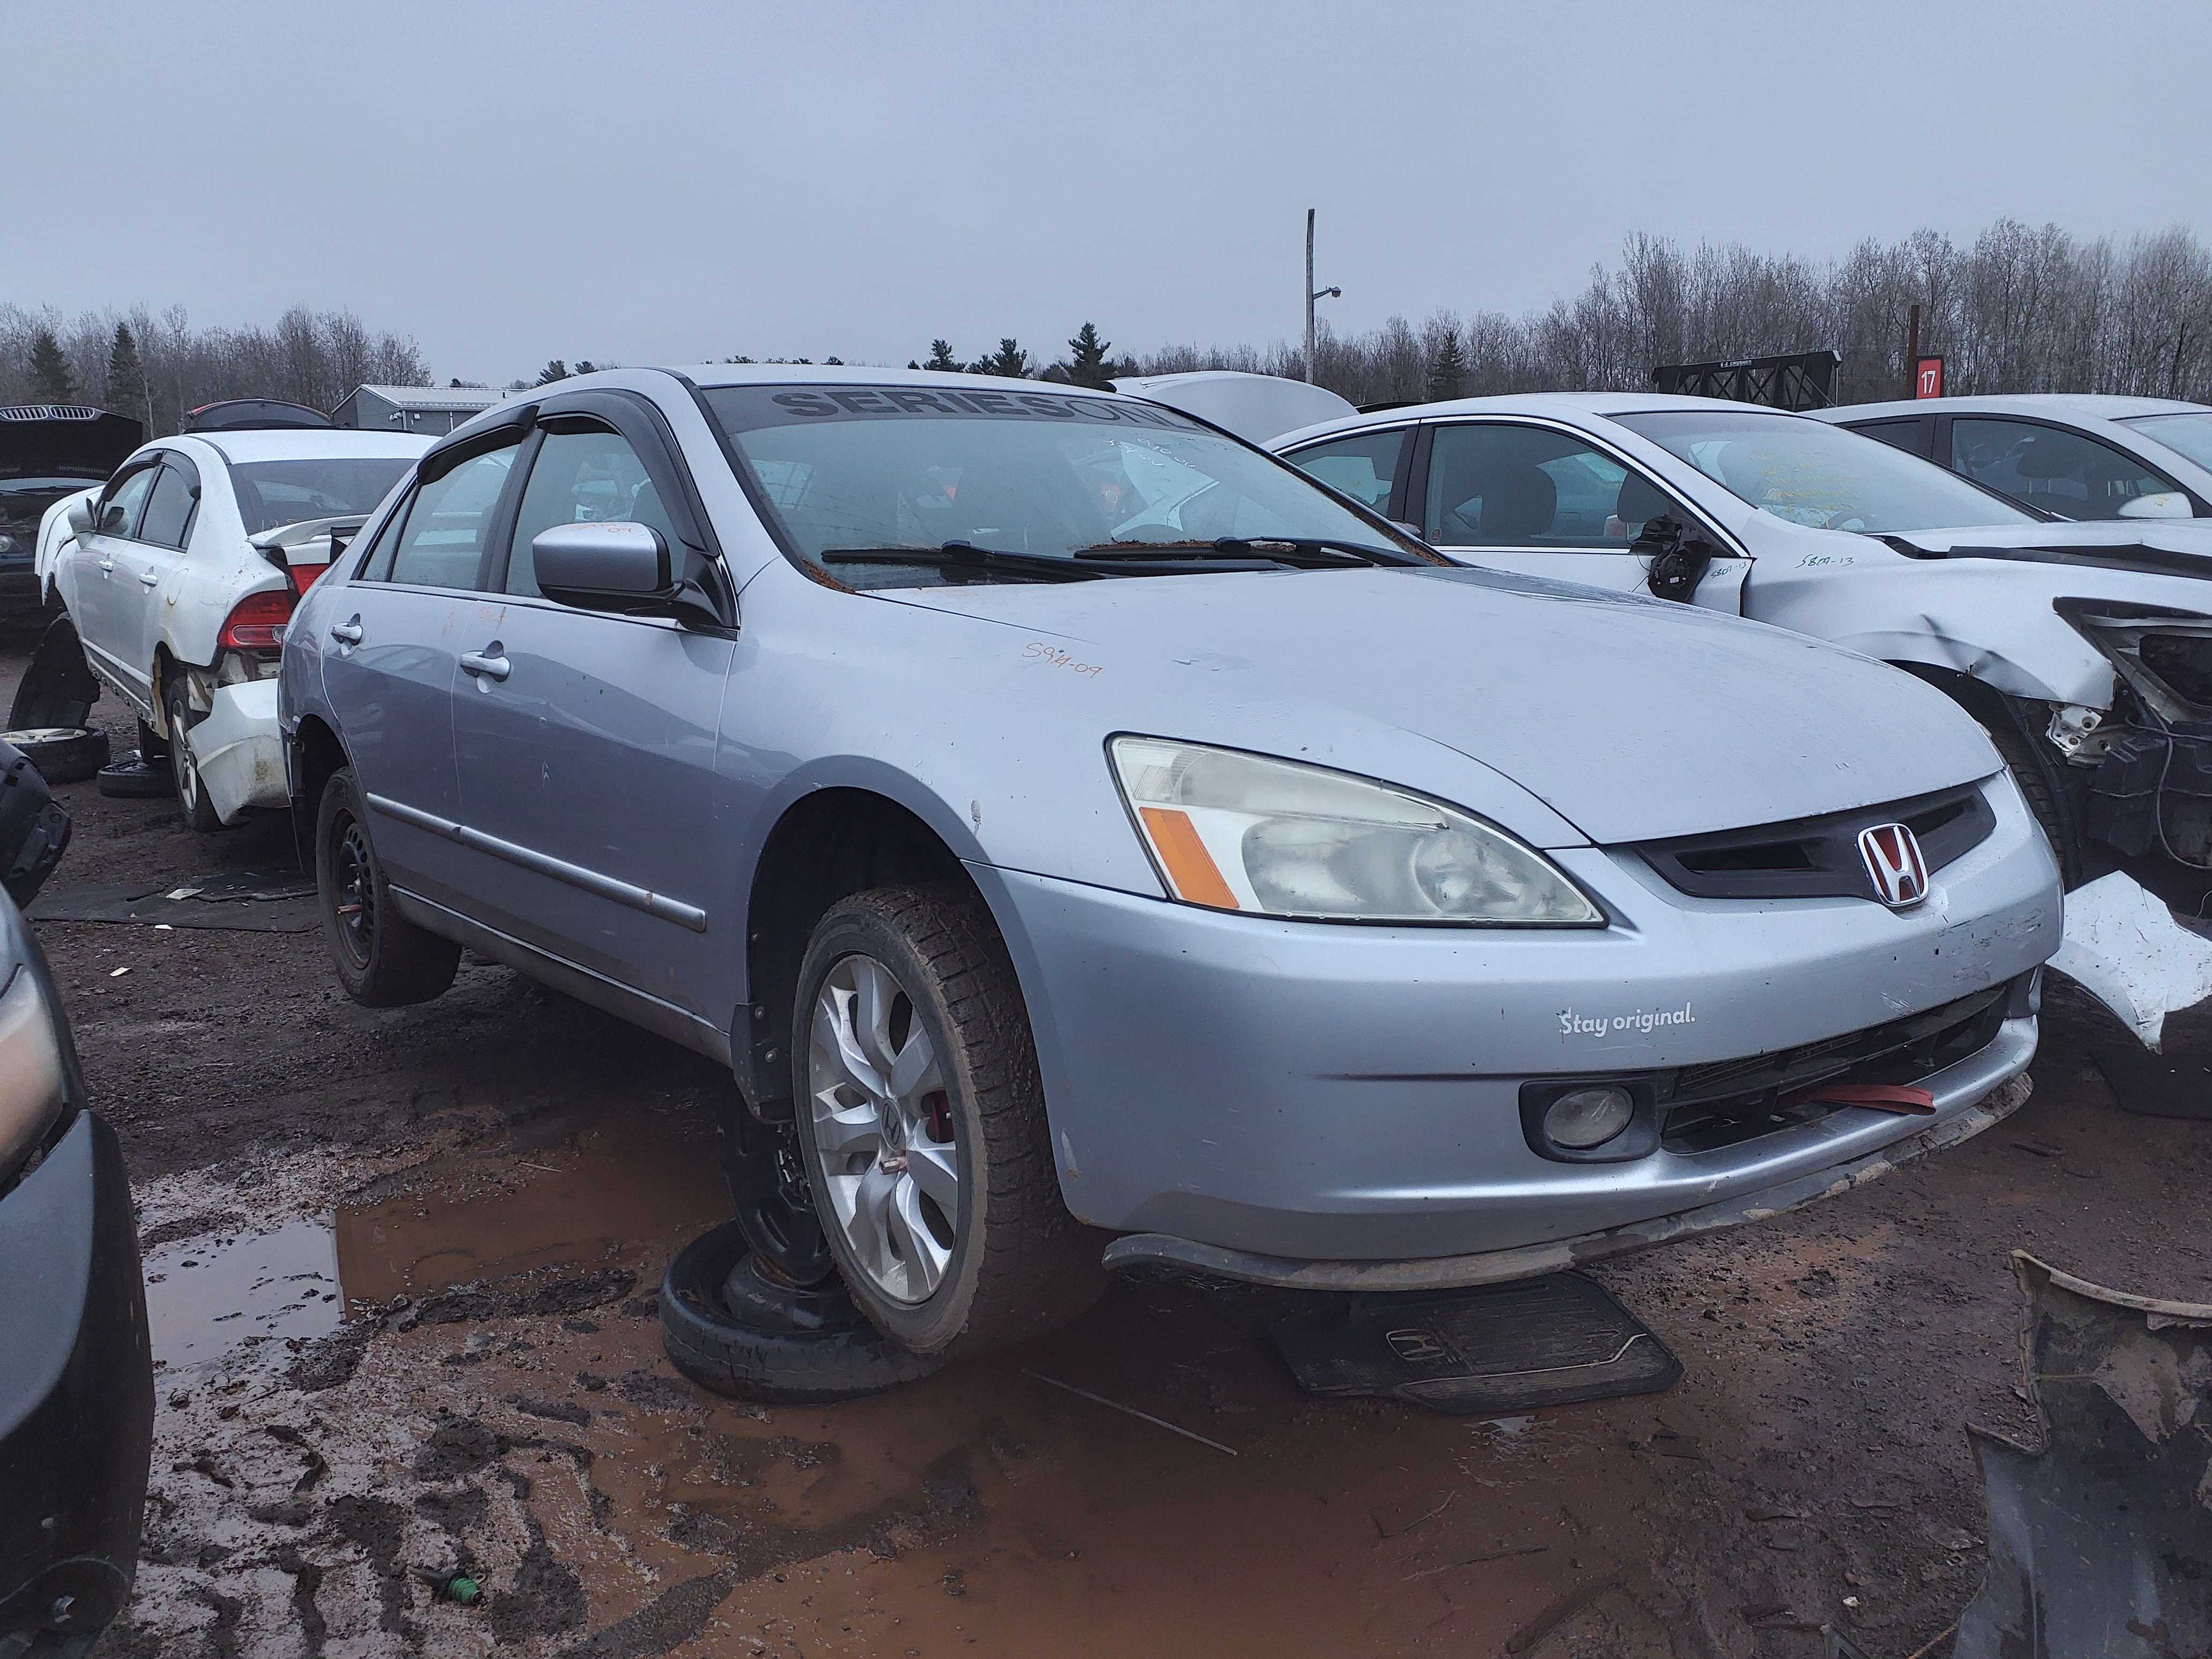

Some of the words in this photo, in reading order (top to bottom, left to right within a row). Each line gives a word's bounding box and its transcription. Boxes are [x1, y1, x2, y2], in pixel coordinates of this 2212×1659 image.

[1921, 370, 1936, 394] 17
[1557, 1007, 1608, 1037] Stay
[1612, 1002, 1697, 1033] original.
